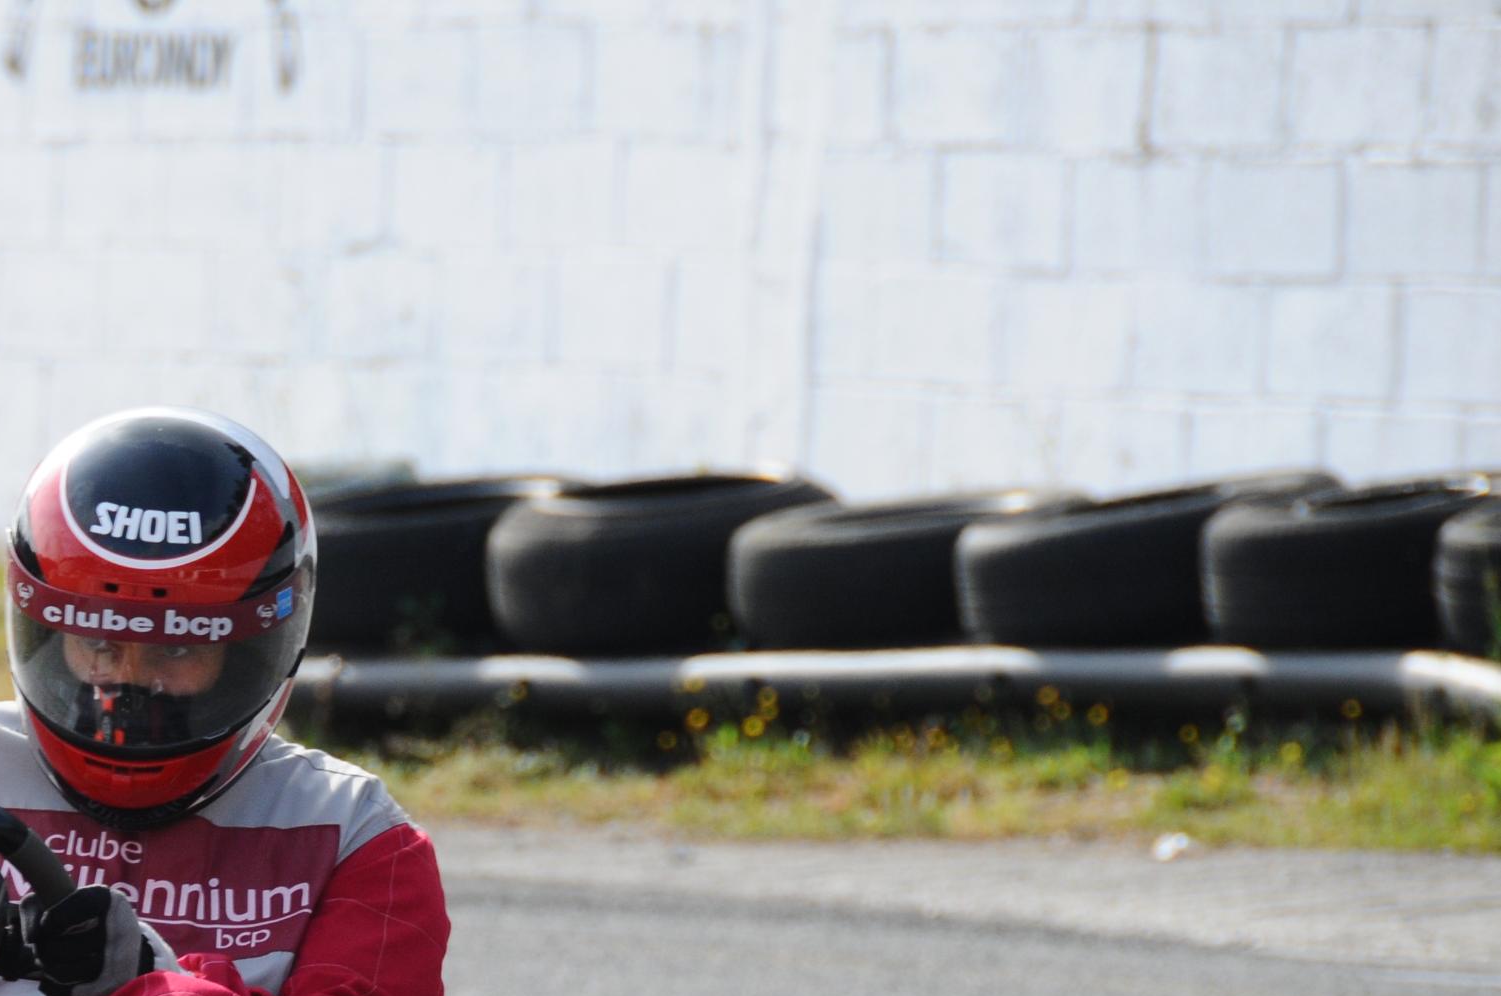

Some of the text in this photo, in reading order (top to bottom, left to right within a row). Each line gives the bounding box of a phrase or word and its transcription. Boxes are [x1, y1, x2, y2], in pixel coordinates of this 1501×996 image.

[90, 502, 203, 544] SHOEI
[43, 603, 233, 641] clube bcp
[45, 830, 143, 864] clube
[1, 859, 310, 921] lennium
[215, 928, 271, 949] bcp
